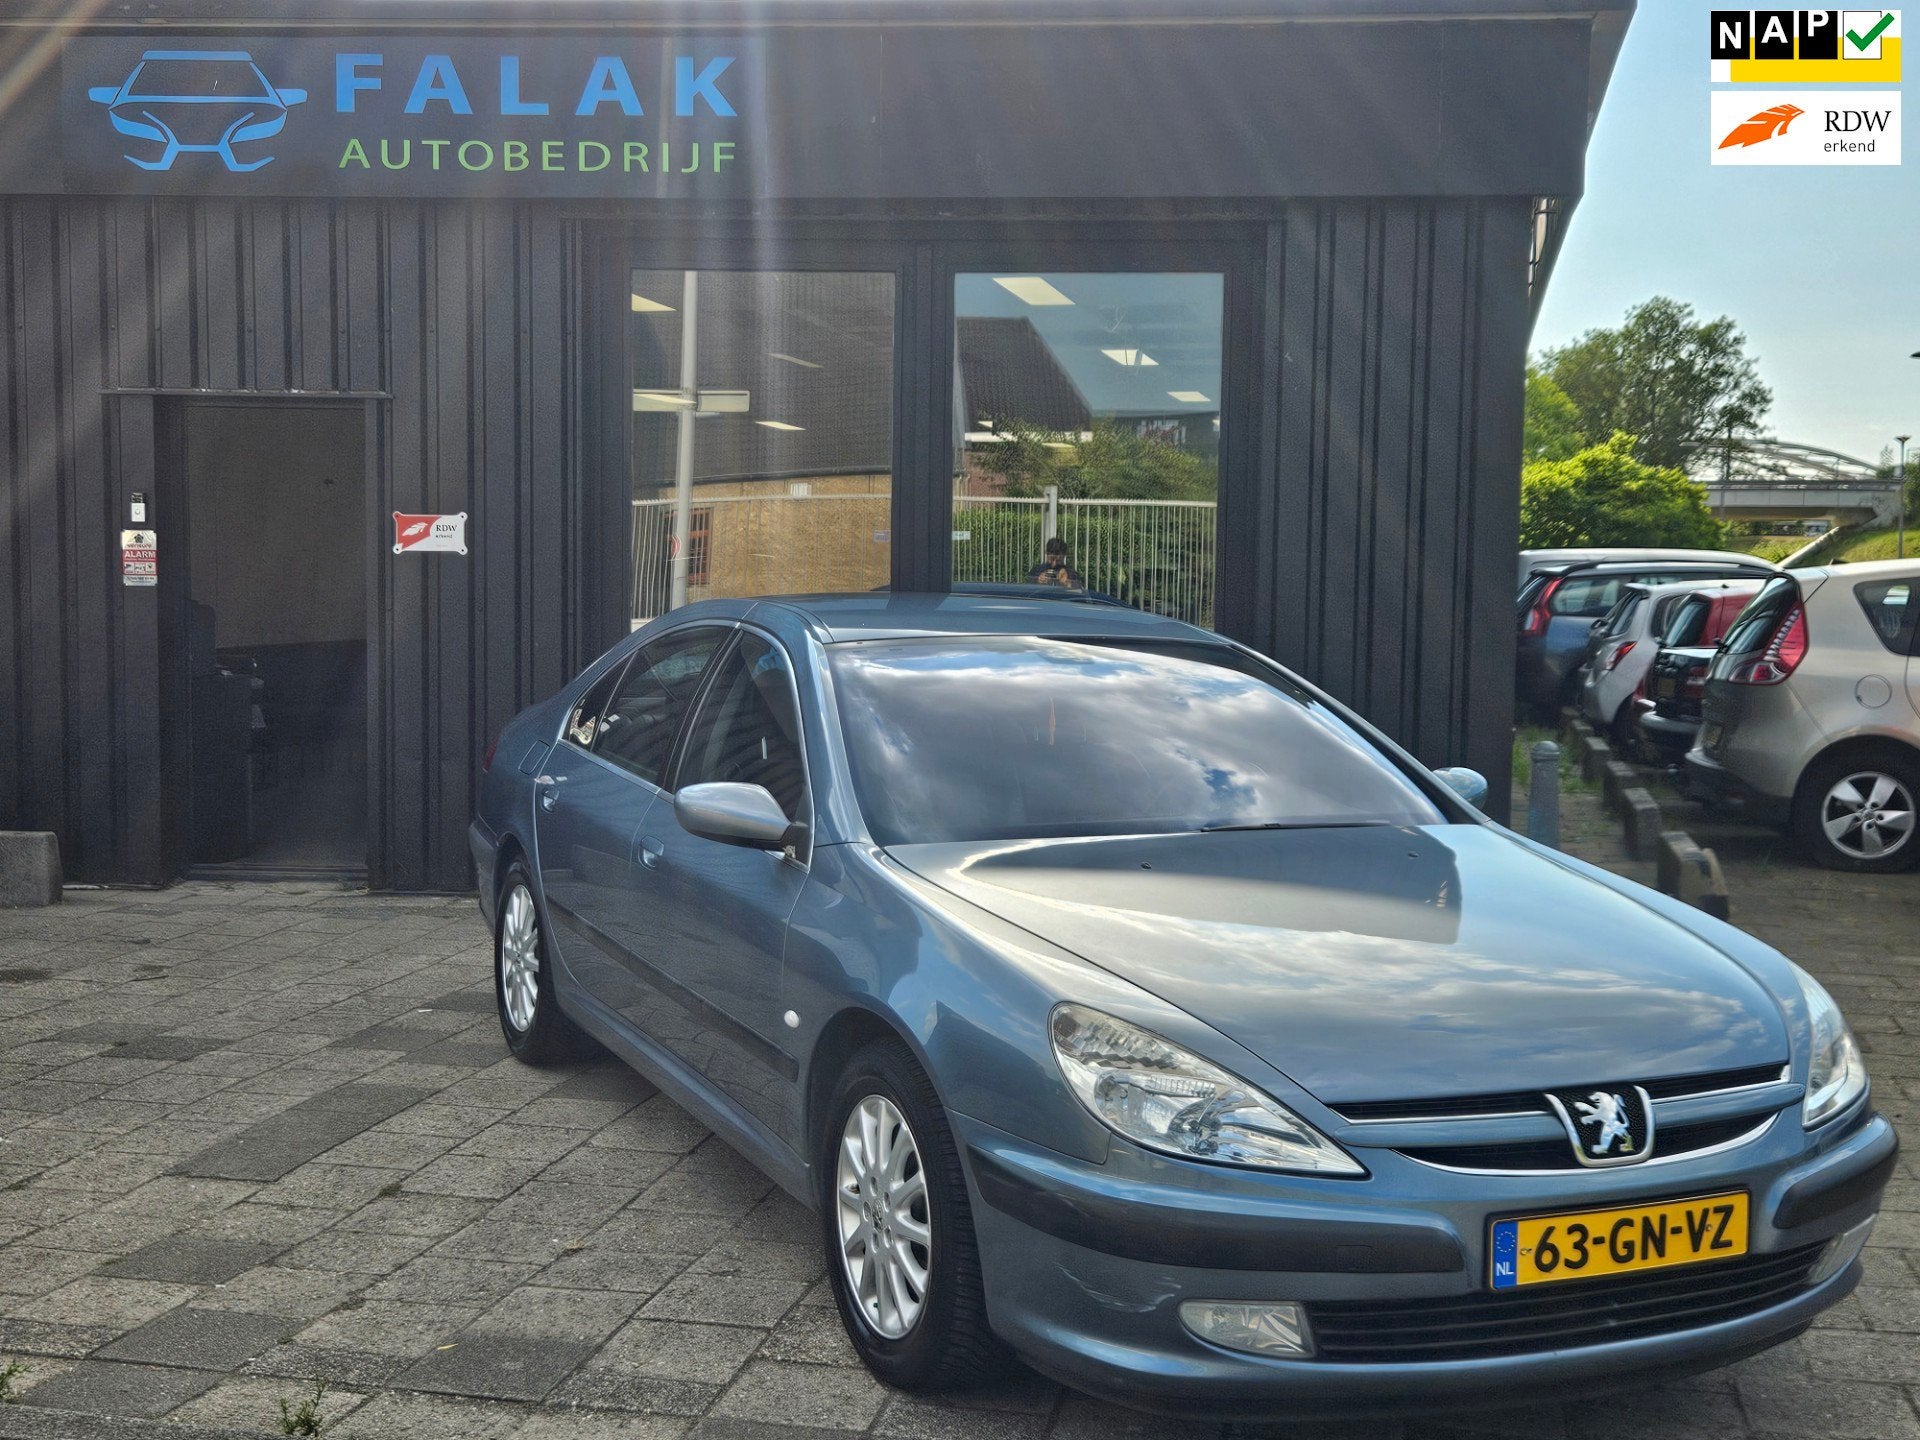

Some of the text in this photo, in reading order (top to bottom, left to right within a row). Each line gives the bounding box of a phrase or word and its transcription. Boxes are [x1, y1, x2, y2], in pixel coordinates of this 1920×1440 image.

[336, 53, 738, 117] FALAK
[338, 138, 737, 173] AUTOBEDRIJF
[125, 550, 156, 558] ALARM
[1534, 1204, 1735, 1273] 63-GN-VZ
[1496, 1262, 1514, 1276] NL
